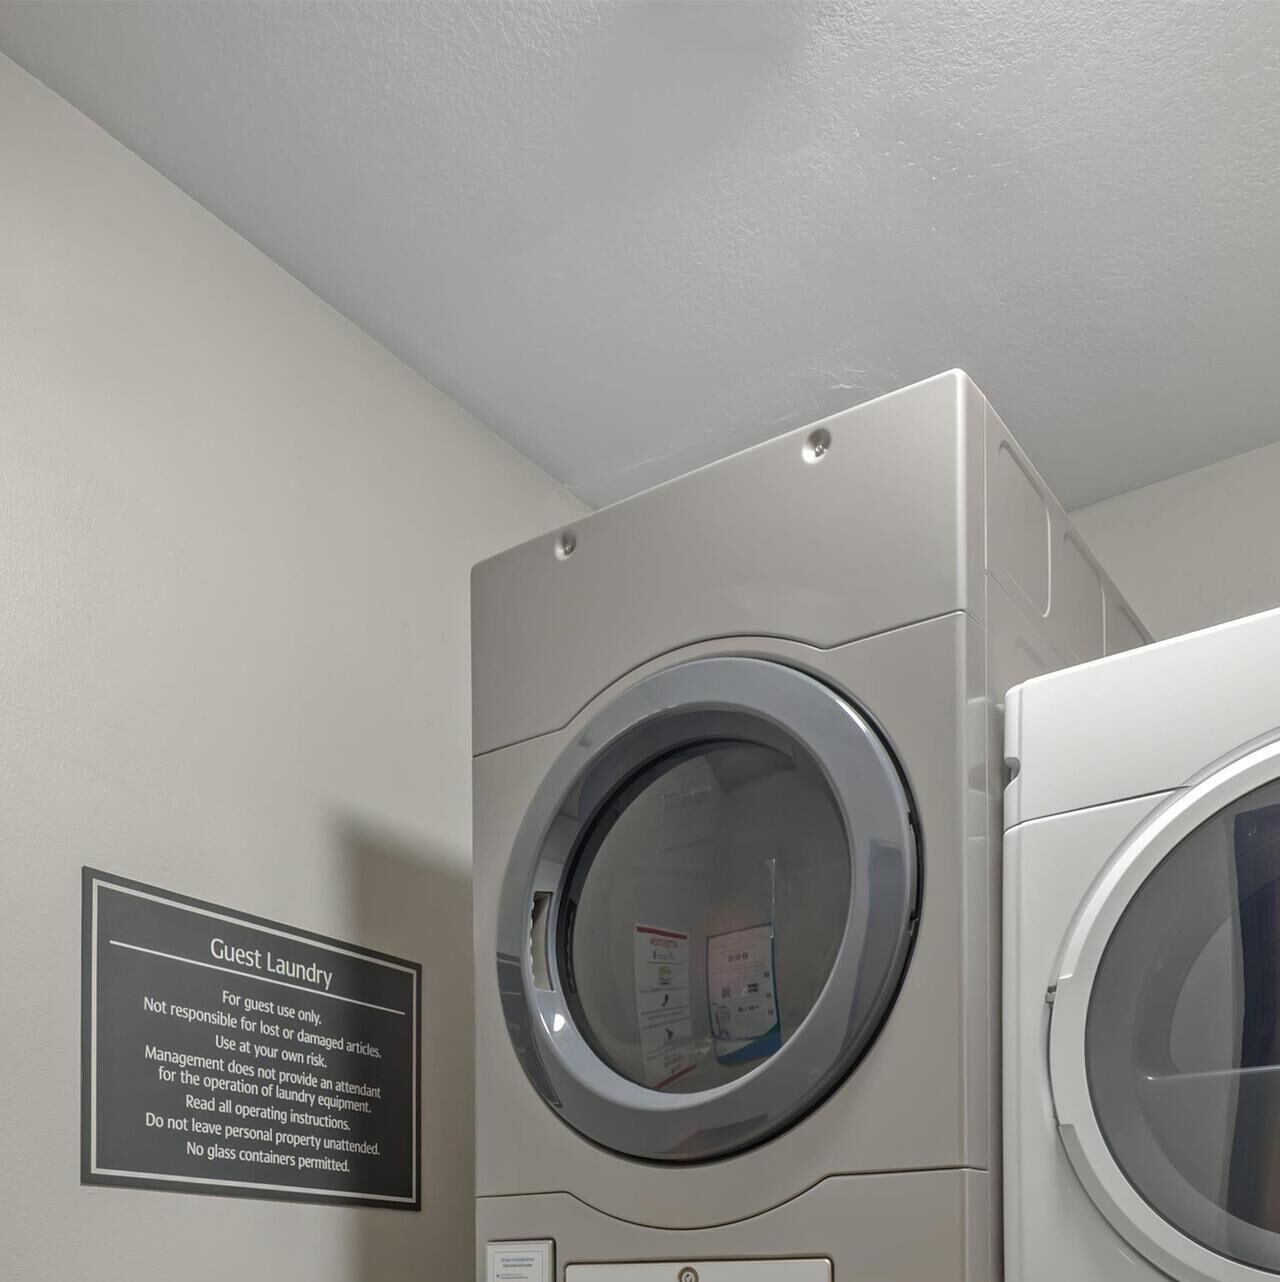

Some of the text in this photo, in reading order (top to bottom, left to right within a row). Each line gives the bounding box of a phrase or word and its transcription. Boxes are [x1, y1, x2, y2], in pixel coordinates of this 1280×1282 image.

[209, 936, 333, 991] Guest Laundry
[142, 995, 382, 1059] Not responsible for lost or damaged articles.
[221, 989, 322, 1027] For guest use only.
[143, 1043, 382, 1099] Management does not provide an attendant
[214, 1033, 328, 1069] Use at your own risk.
[157, 1064, 372, 1114] for the operation of laundry equipment.
[144, 1111, 381, 1156] Do not leave personal property unattended.
[185, 1093, 351, 1132] Read all operating instructions.
[185, 1140, 351, 1173] No glass containers permitted.
